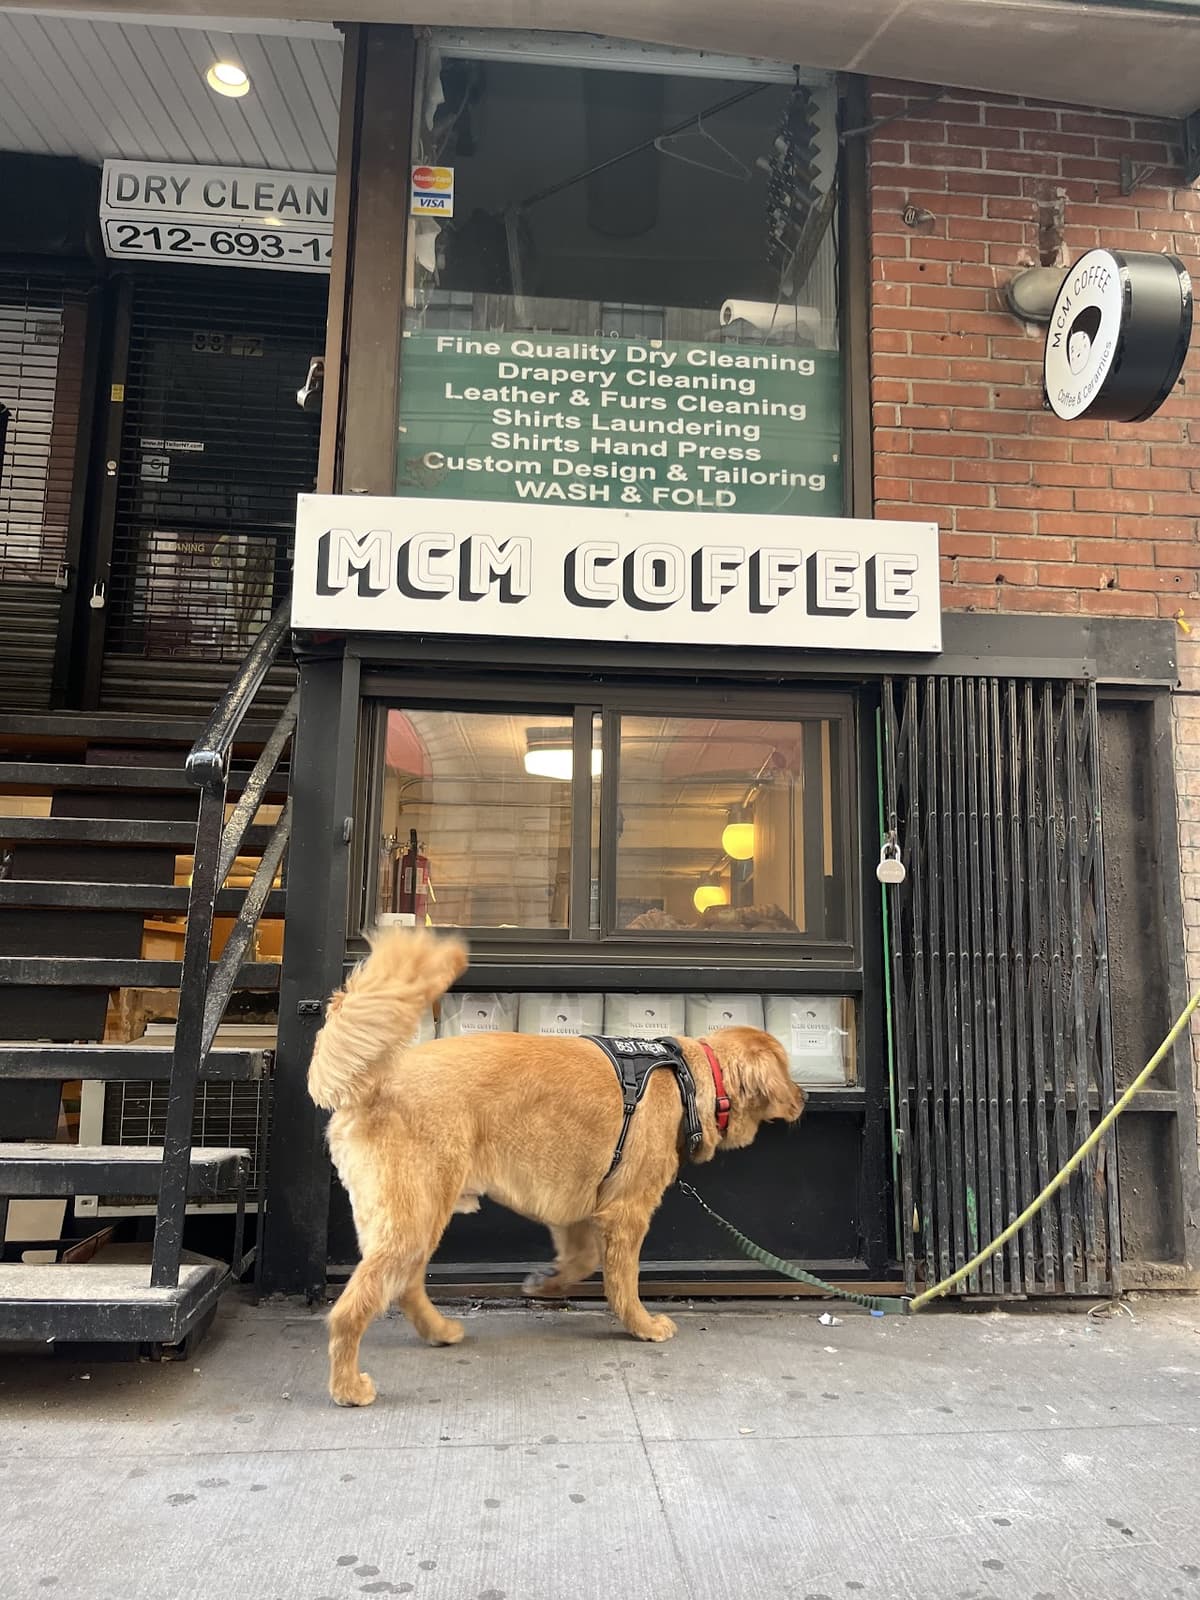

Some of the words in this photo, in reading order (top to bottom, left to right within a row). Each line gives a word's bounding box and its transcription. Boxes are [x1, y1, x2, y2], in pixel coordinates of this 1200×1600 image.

[117, 173, 191, 205] DRY
[203, 179, 328, 216] CLEAN
[420, 198, 444, 208] VISA
[117, 225, 332, 261] 212-693-1
[1052, 296, 1072, 348] MCM
[1074, 266, 1111, 295] COFFEE
[437, 336, 500, 355] Fine
[511, 340, 617, 364] Quality
[626, 346, 677, 368] Dry
[686, 349, 815, 376] Cleaning
[1058, 389, 1076, 407] Coffee
[1083, 341, 1112, 398] Ceramics
[498, 362, 617, 388] Drapery
[626, 369, 756, 395] Cleaning
[445, 382, 560, 405] Leather
[569, 389, 590, 406] &
[601, 391, 667, 410] Furs
[677, 395, 807, 420] Cleaning
[492, 409, 581, 429] Shirts
[592, 413, 760, 441] Laundering
[490, 432, 580, 453] Shirts
[591, 437, 668, 459] Hand
[678, 441, 762, 461] Press
[423, 452, 541, 474] Custom
[552, 459, 656, 482] Design
[667, 464, 689, 481] &
[697, 465, 825, 491] Tailoring
[515, 480, 610, 502] WASH
[620, 486, 642, 503] &
[653, 487, 736, 507] FOLD
[316, 529, 532, 604] MCM
[564, 540, 919, 620] COFFEE
[614, 1040, 638, 1053] BEST
